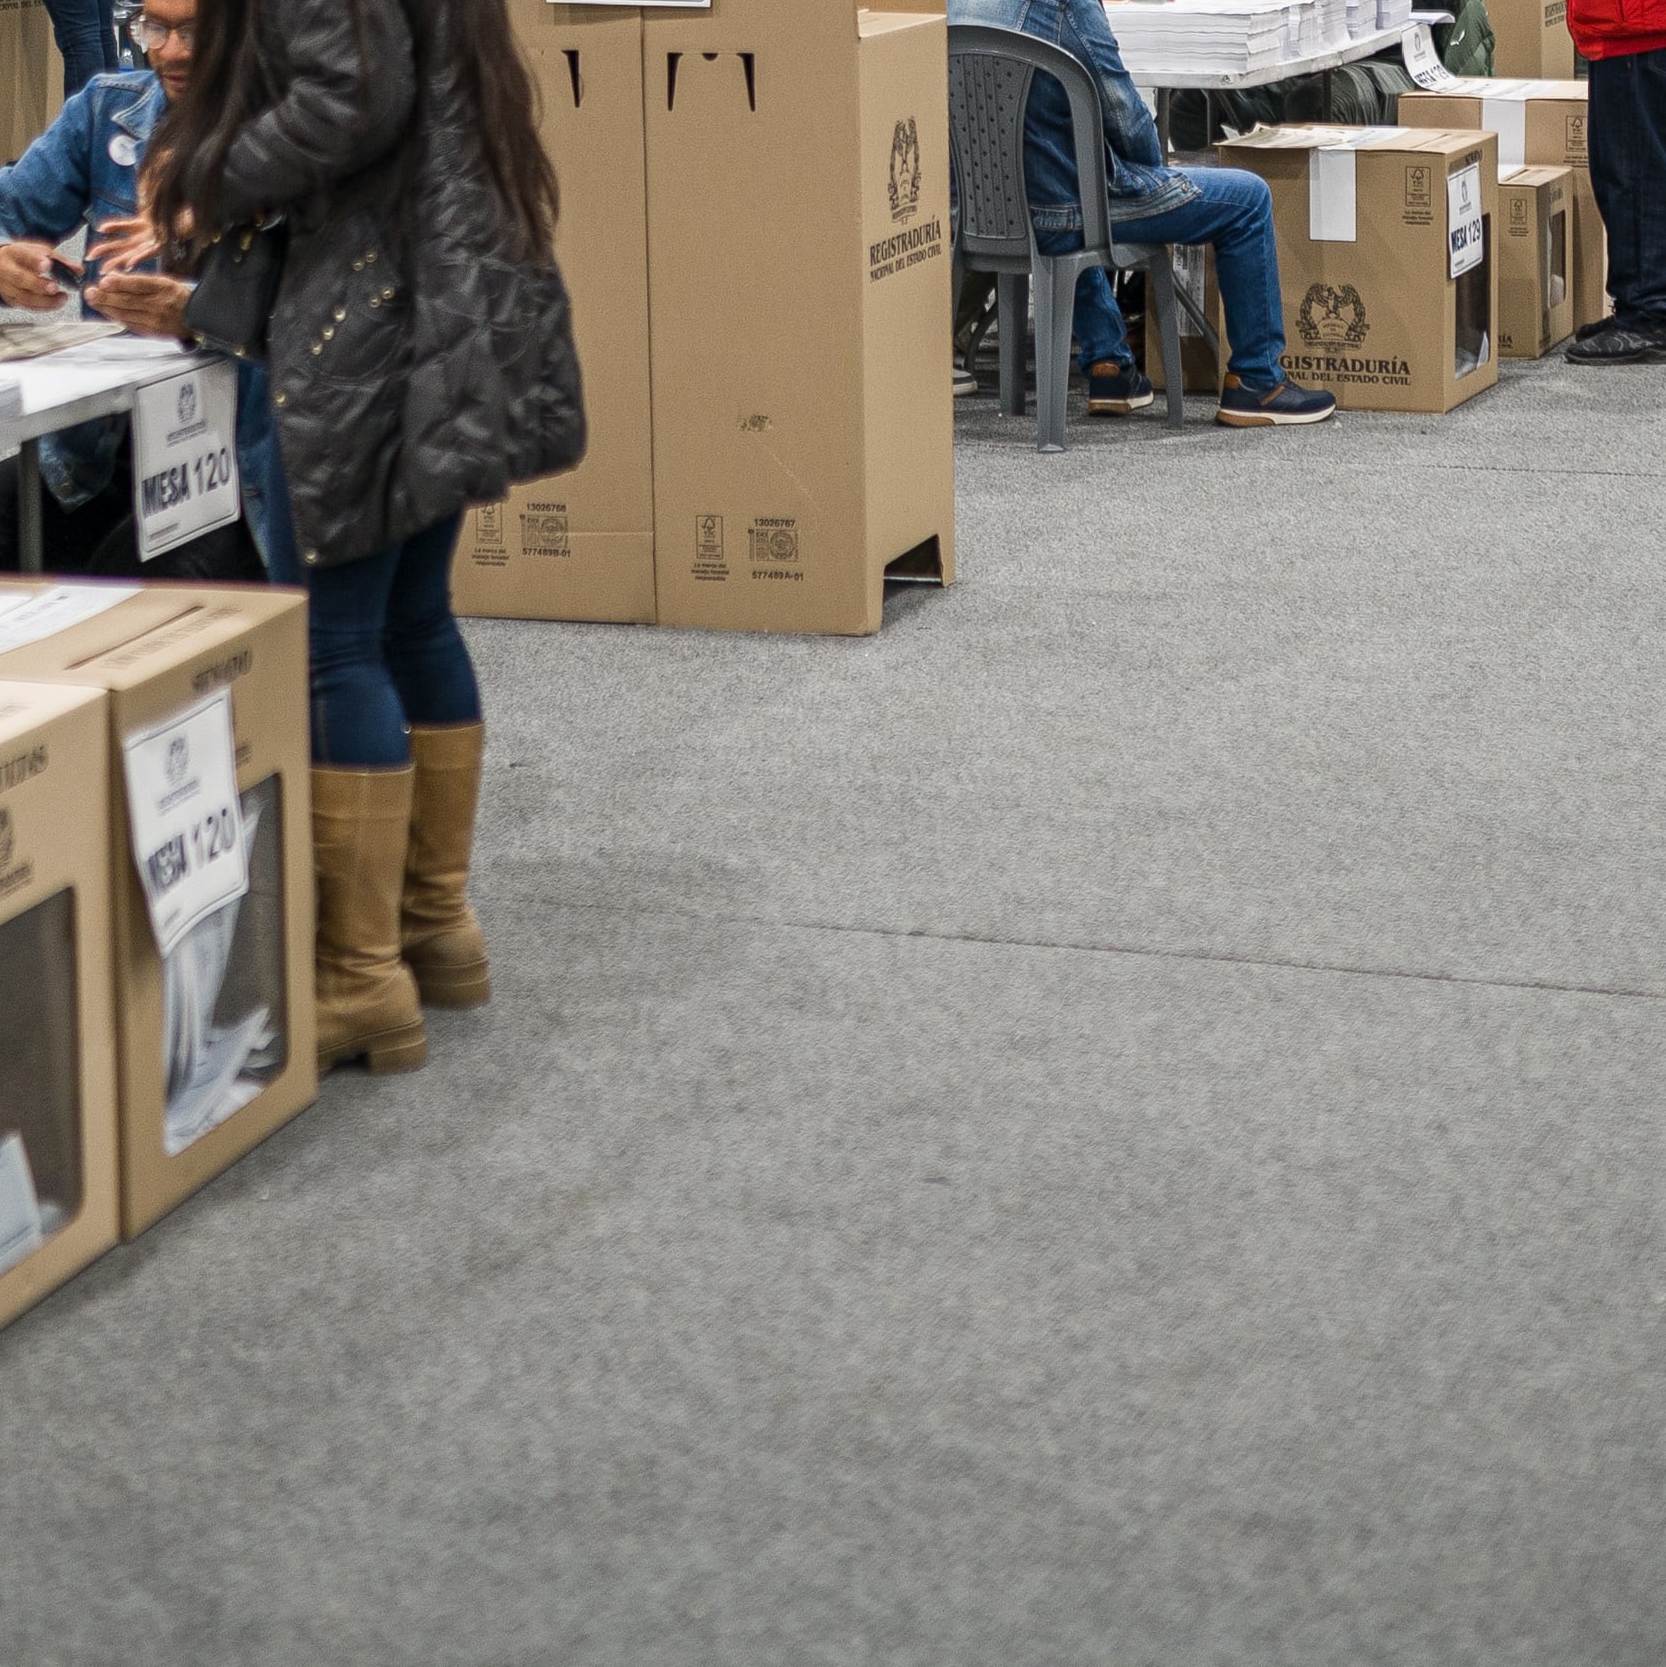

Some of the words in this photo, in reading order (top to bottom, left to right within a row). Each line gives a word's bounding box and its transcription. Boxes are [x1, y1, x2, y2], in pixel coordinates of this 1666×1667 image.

[870, 214, 941, 267] REGISTRADURÍA
[1450, 225, 1467, 253] MESA
[1468, 219, 1480, 246] 129
[870, 263, 894, 283] NACIONAL
[896, 258, 905, 271] DEL
[907, 249, 926, 267] ESTADO
[928, 244, 941, 258] CIVIL
[1280, 355, 1411, 375] GISTRADURÍA
[141, 462, 190, 519] MESA
[195, 447, 230, 495] 120
